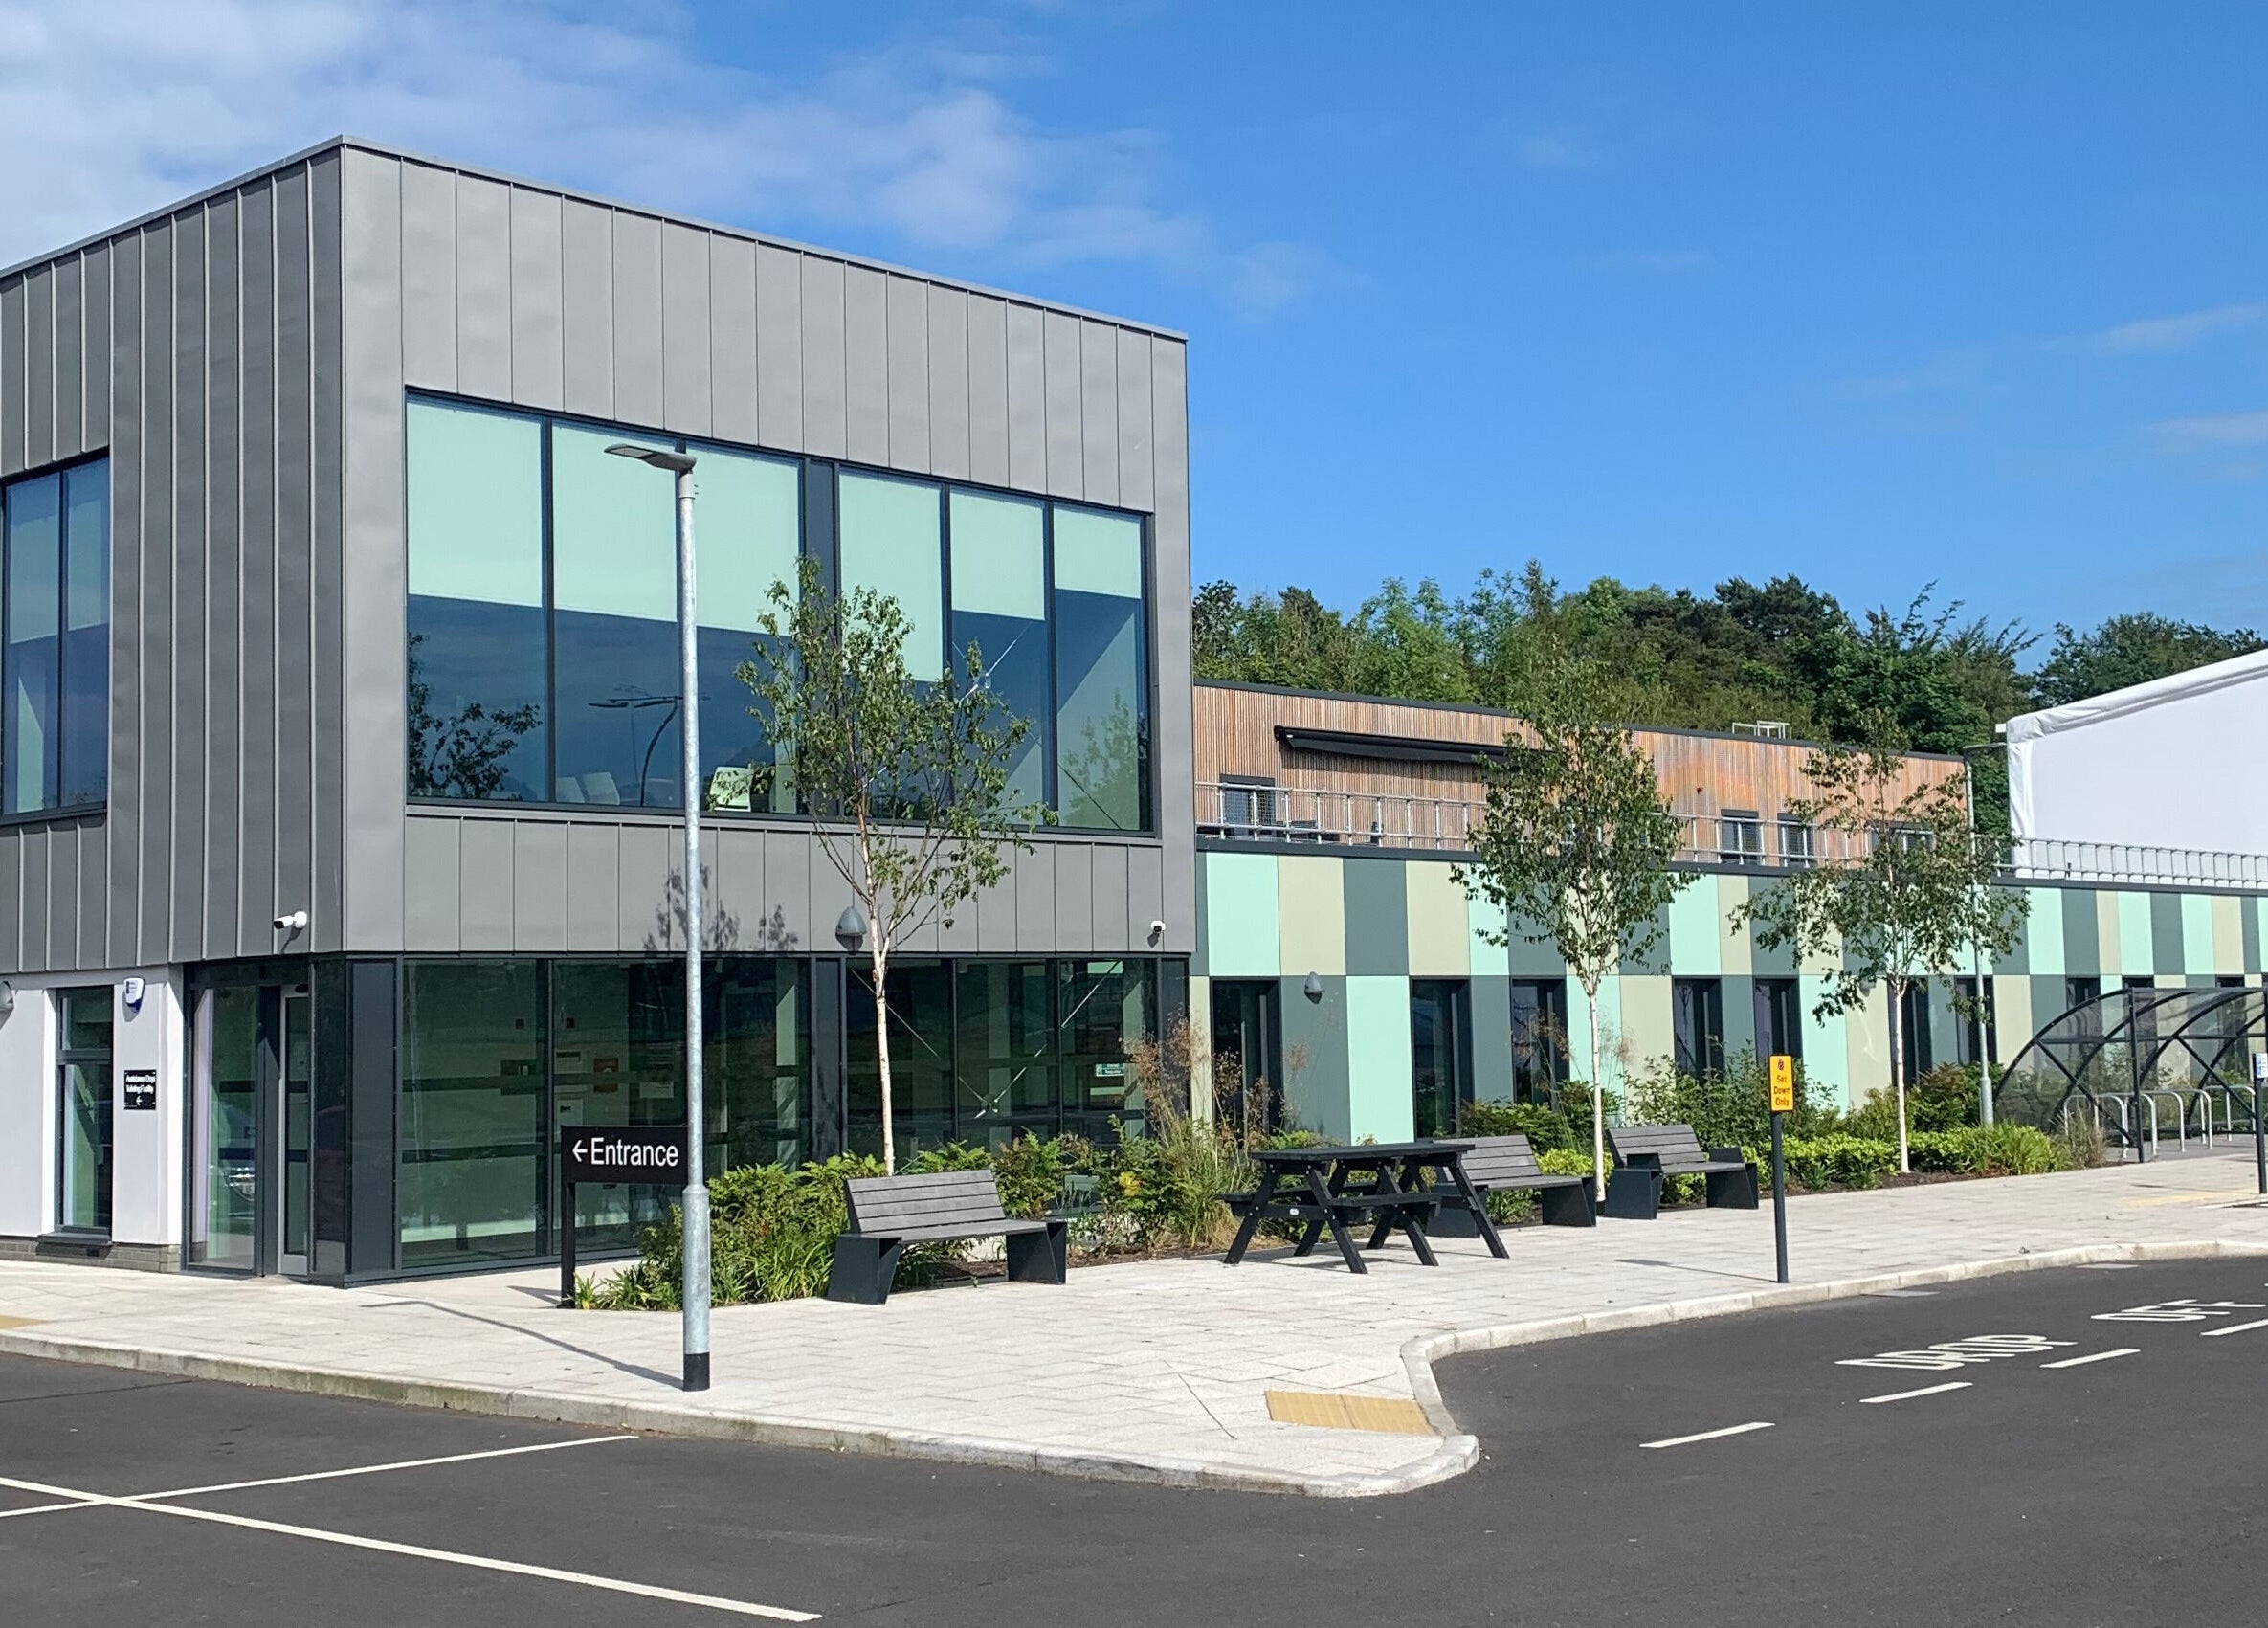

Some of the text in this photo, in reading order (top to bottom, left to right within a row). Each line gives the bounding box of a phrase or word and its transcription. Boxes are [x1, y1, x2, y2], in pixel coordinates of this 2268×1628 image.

[591, 1137, 678, 1167] Entrance
[1834, 1299, 2266, 1370] DROP OFF
